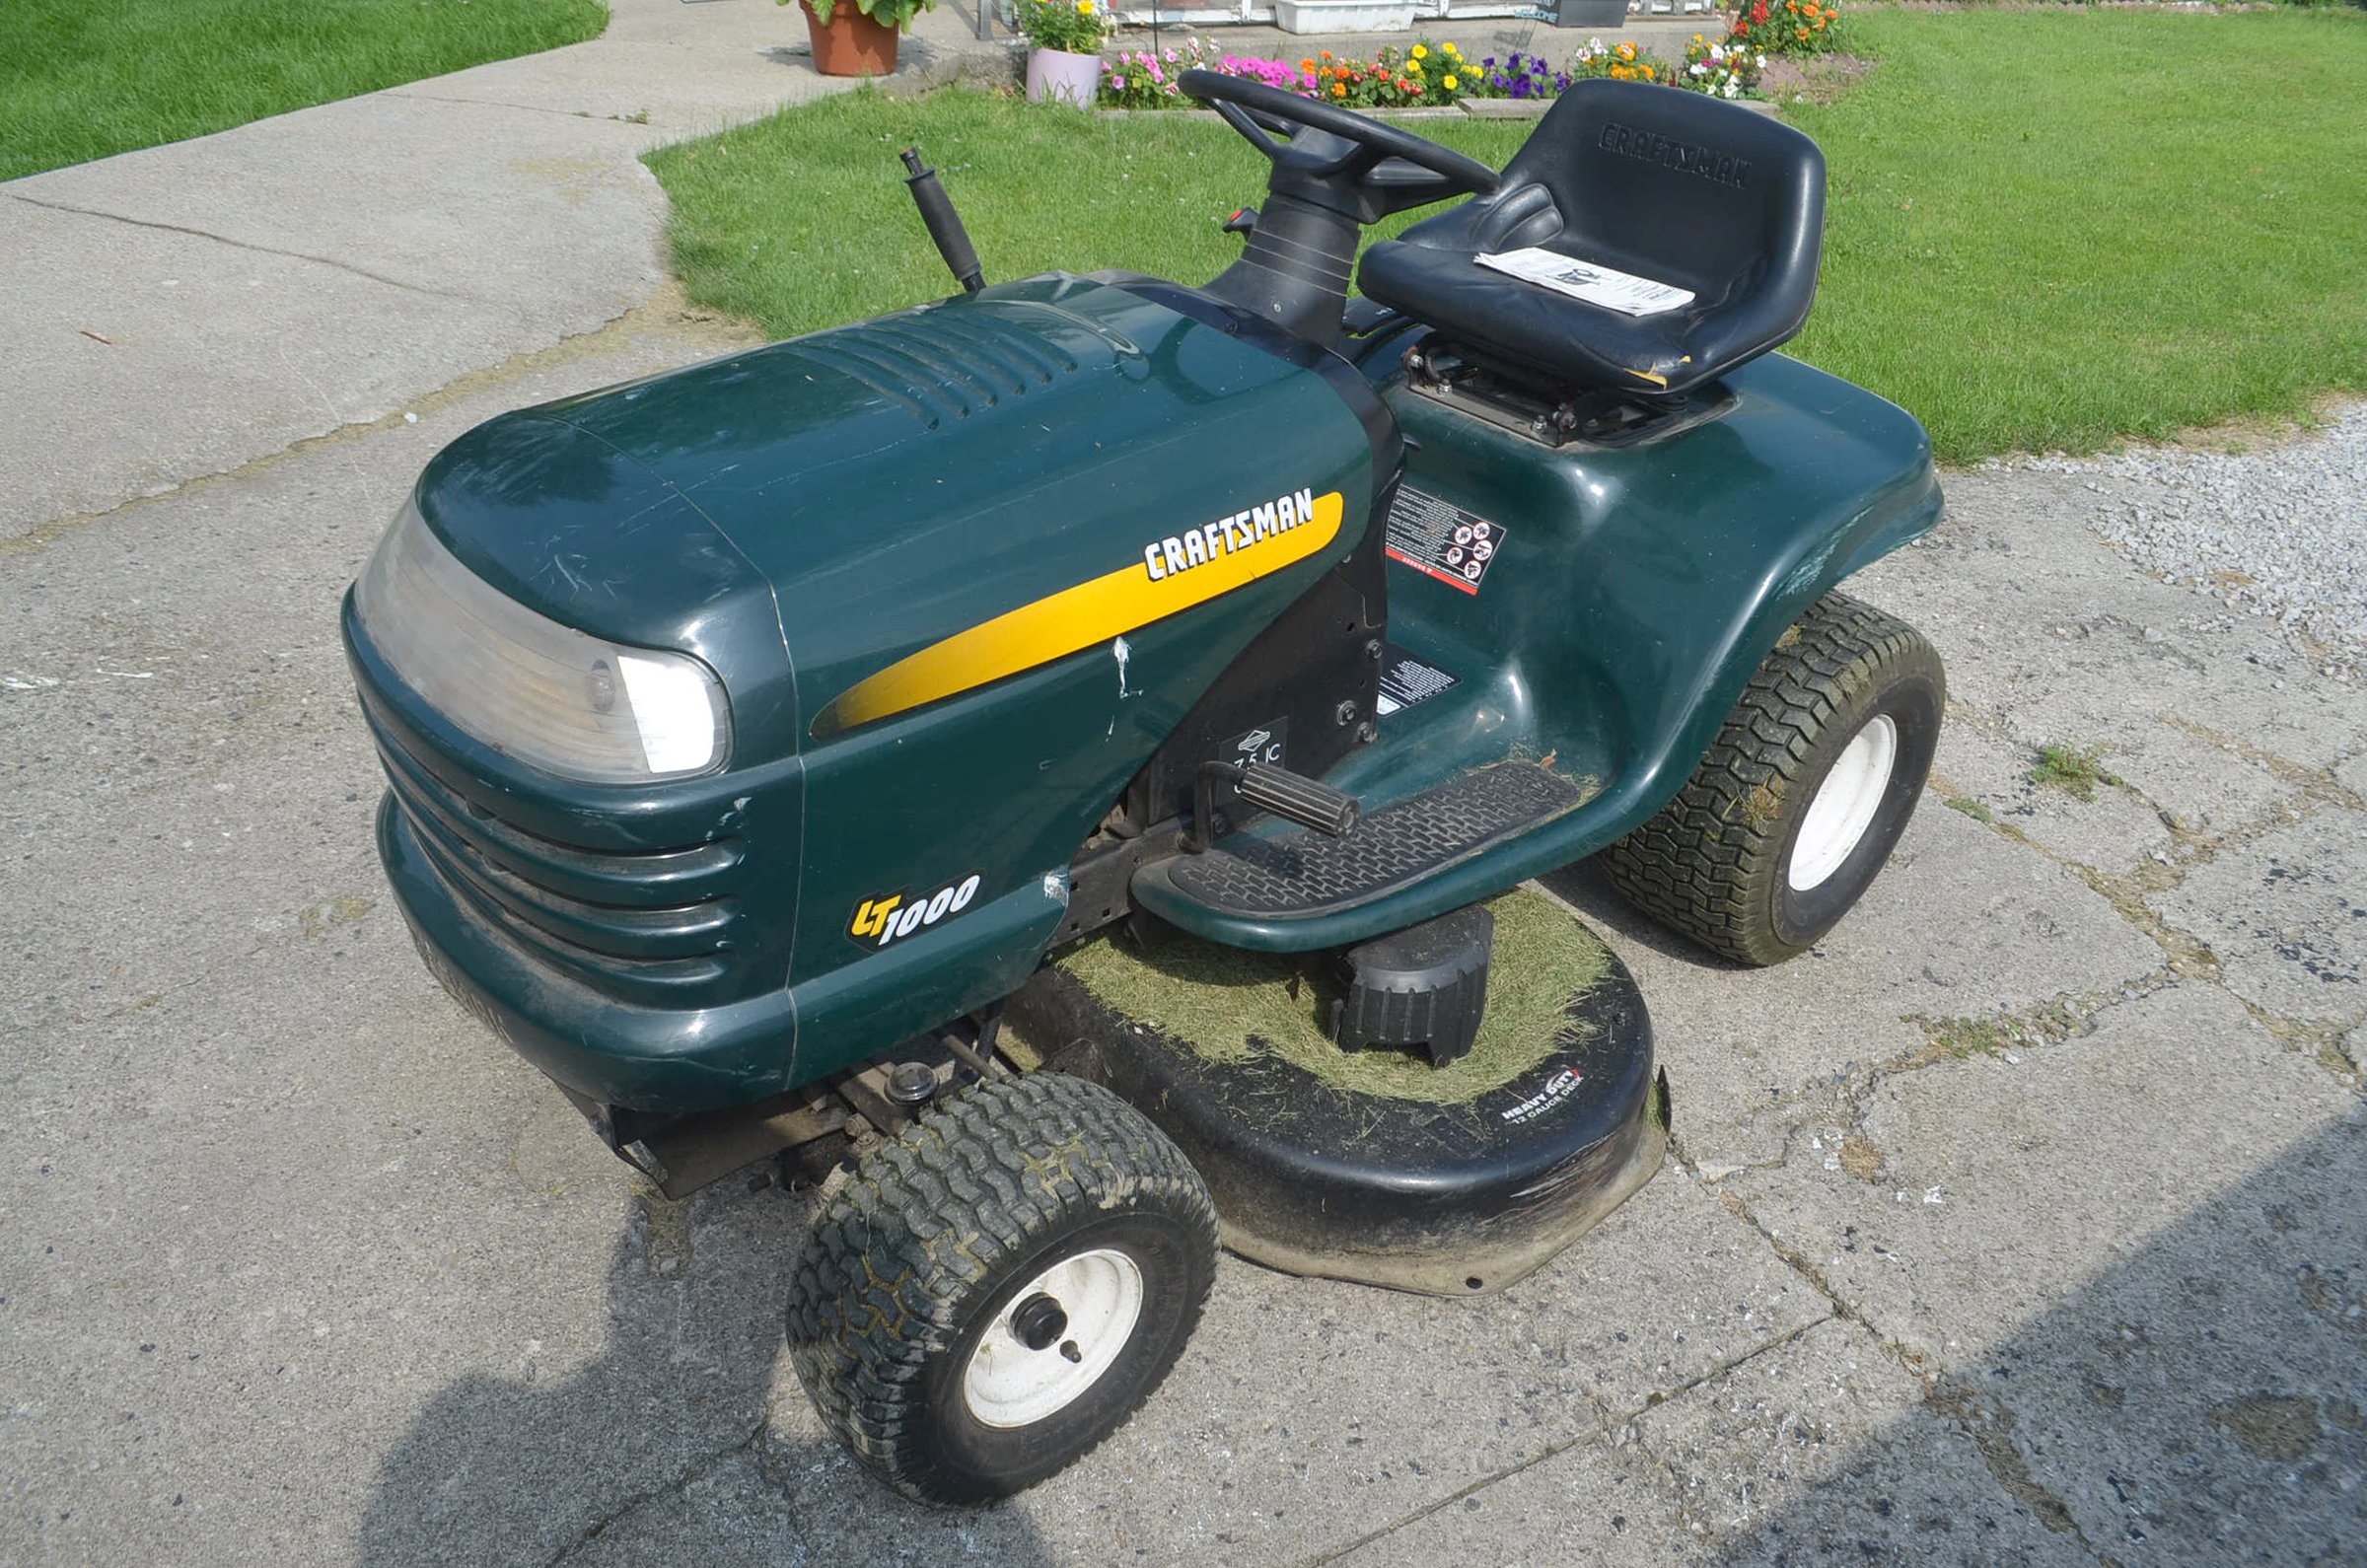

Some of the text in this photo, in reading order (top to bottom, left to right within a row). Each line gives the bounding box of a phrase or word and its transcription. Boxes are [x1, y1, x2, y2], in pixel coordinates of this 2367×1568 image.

[1599, 122, 1752, 189] CRAFTSMAN
[1144, 487, 1314, 582] CRAFTSMAN
[1501, 1070, 1574, 1120] HEAVY DUTY
